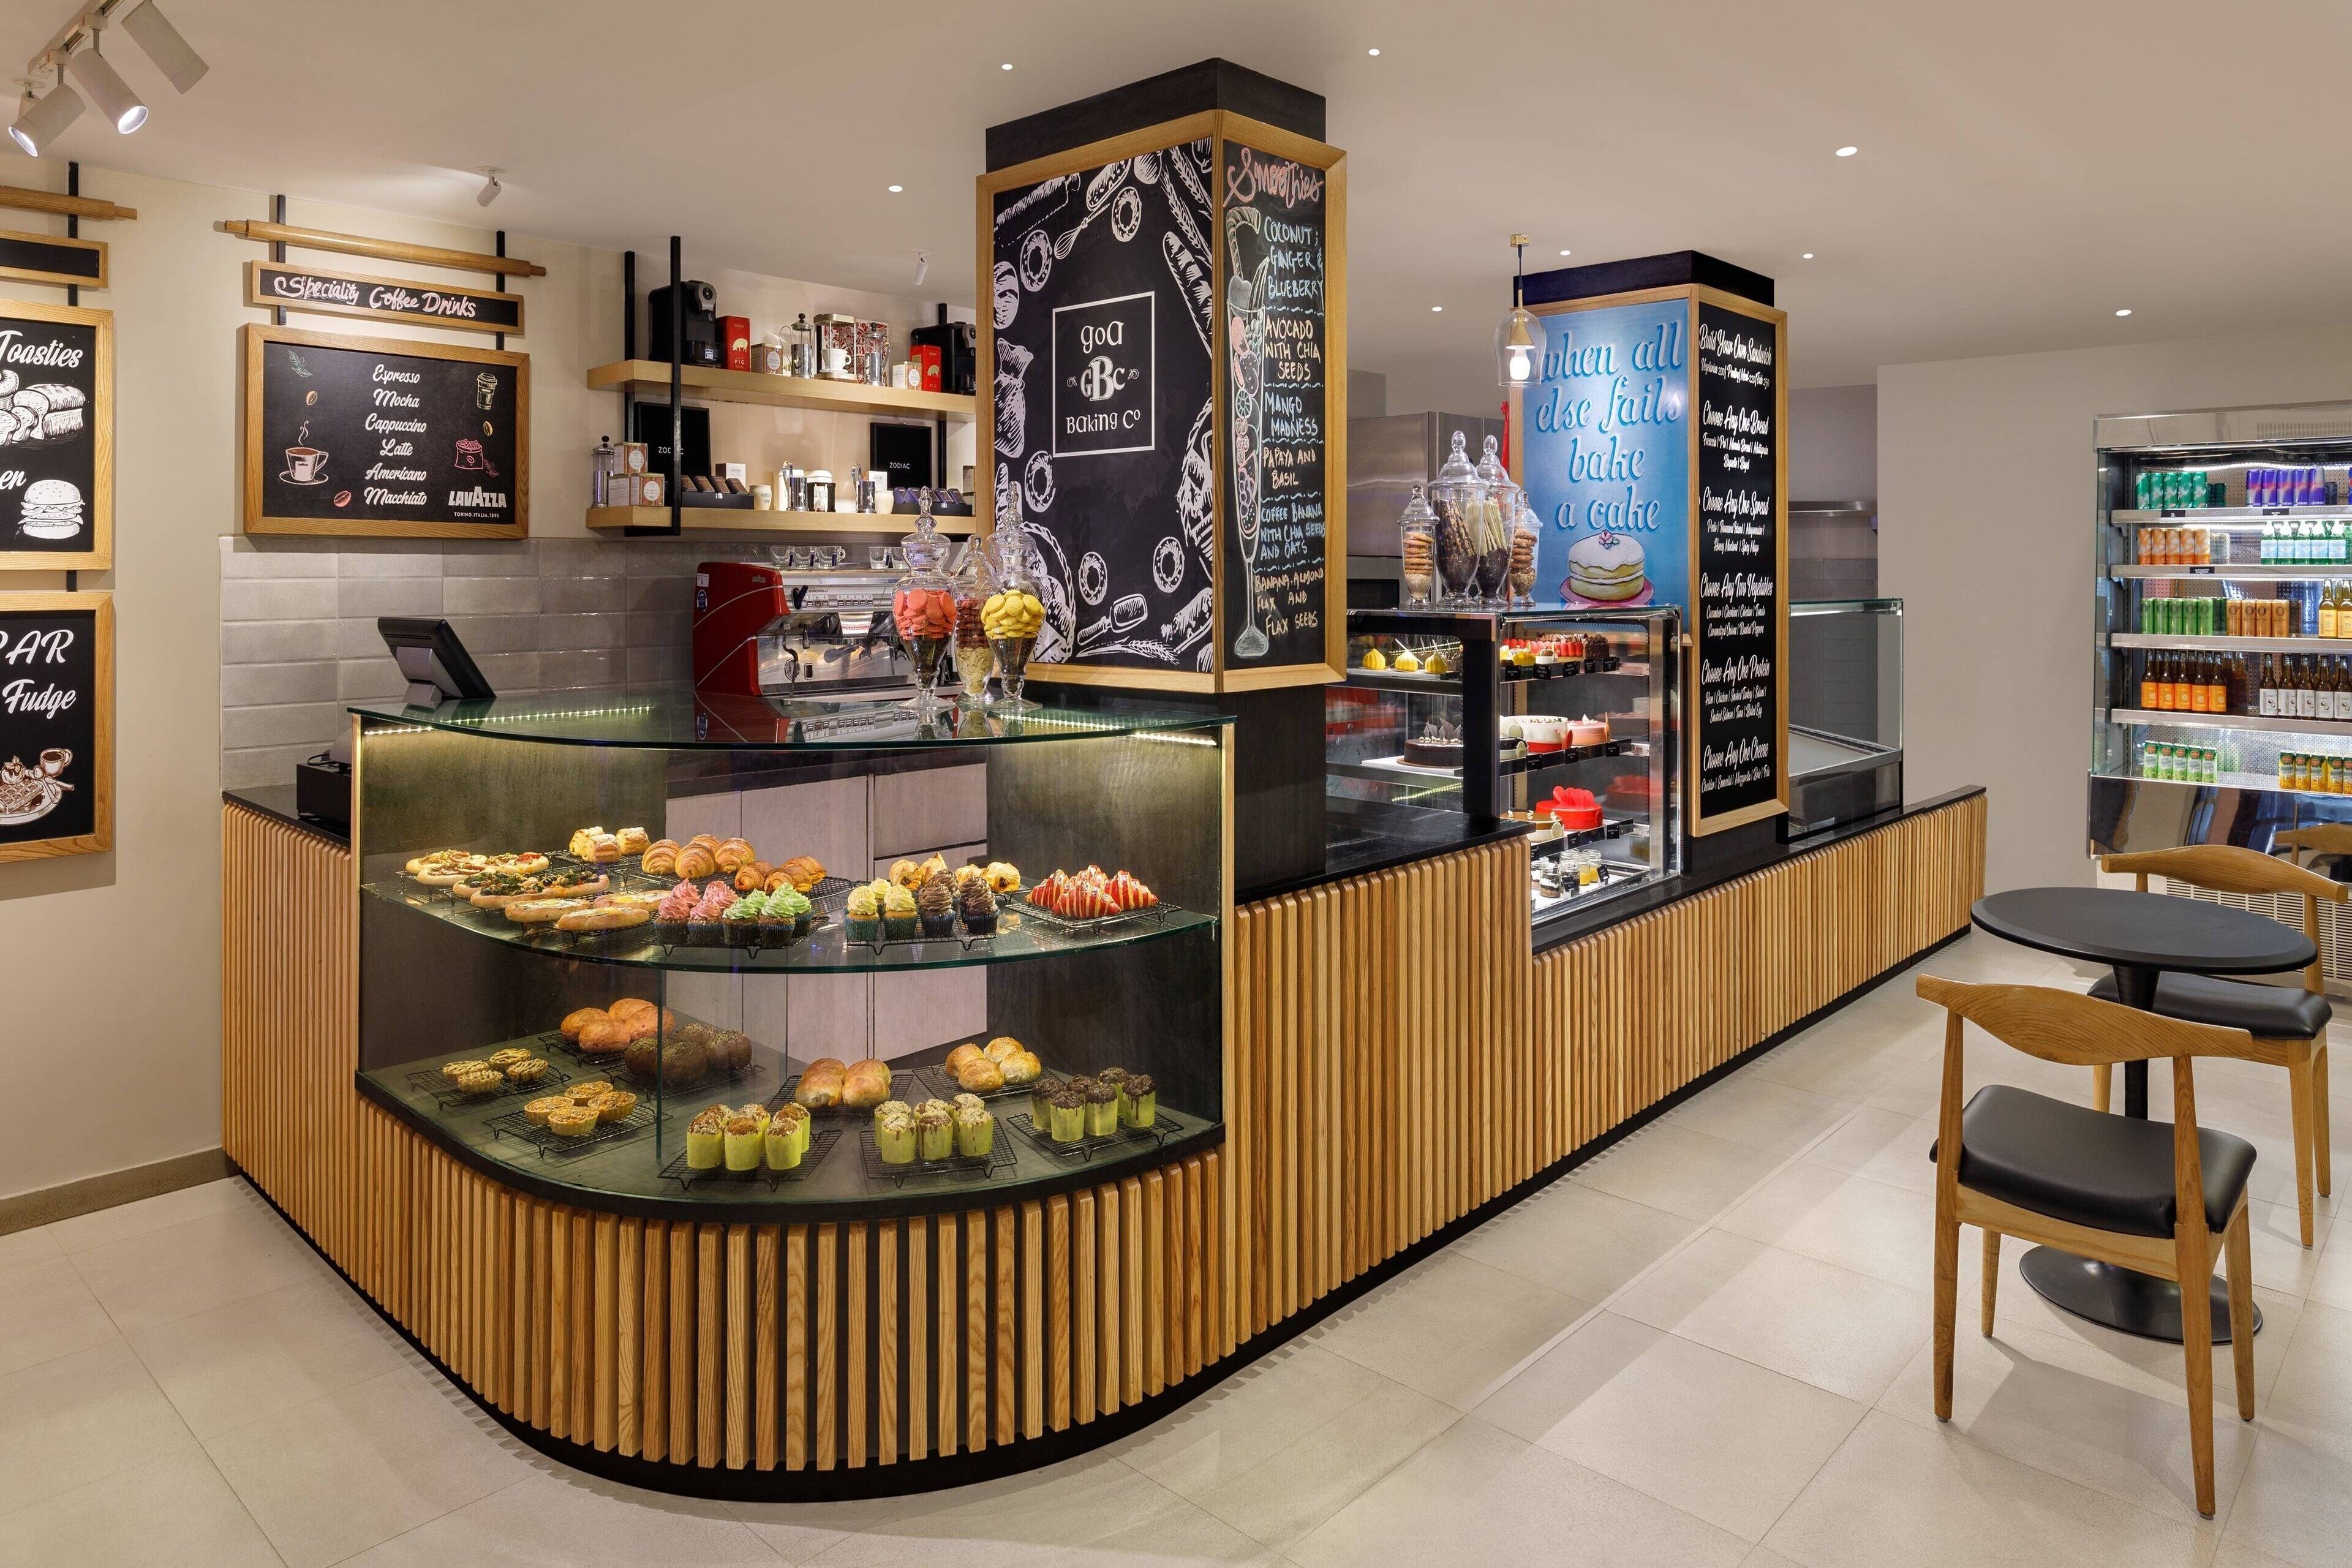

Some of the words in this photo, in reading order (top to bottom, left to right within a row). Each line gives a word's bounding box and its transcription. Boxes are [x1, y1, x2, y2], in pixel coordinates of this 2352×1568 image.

[1223, 147, 1324, 209] Smoothies
[1270, 245, 1316, 275] GINGER
[274, 276, 359, 306] Speciality
[369, 287, 420, 311] Coffee
[422, 292, 476, 318] Drinks
[1267, 275, 1324, 311] BLUEBERRY
[1265, 315, 1313, 339] AVOCADO
[1699, 323, 1717, 351] Build
[1717, 329, 1733, 356] Your
[0, 330, 83, 368] Toasties
[1265, 341, 1291, 360] WITH
[1297, 341, 1321, 364] CHIA
[1535, 330, 1620, 383] when
[1632, 320, 1684, 371] all
[372, 363, 420, 385] Espresso
[1277, 361, 1311, 382] SEEDS
[373, 388, 420, 408] Mocha
[1264, 391, 1302, 421] MANGO
[1536, 383, 1591, 434] else
[1598, 374, 1682, 434] fails
[365, 412, 427, 434] Cappuccino
[1270, 417, 1317, 437] MADNESS
[1703, 400, 1724, 427] Choose
[1724, 405, 1738, 436] Any
[1738, 407, 1750, 432] One
[1750, 410, 1769, 435] Bread
[379, 438, 413, 457] Latte
[1262, 447, 1294, 468] PAPAYA
[1297, 448, 1316, 465] AND
[1569, 434, 1645, 484] bake
[365, 462, 427, 481] Americano
[1272, 470, 1299, 489] BASIL
[364, 486, 428, 505] Macchiato
[448, 486, 507, 508] LAVAZZA
[1556, 499, 1577, 531] a
[1587, 483, 1660, 532] cake
[1703, 486, 1724, 511] Choose
[1724, 489, 1738, 519] Any
[1738, 489, 1750, 514] One
[1750, 491, 1770, 521] Spread
[1261, 506, 1288, 523] COFFEE
[1291, 502, 1323, 522] BANANA
[1261, 526, 1282, 543] WITH
[1284, 524, 1303, 543] CHIA
[1305, 521, 1325, 538] SEEDS
[1260, 543, 1280, 561] AND
[1284, 539, 1308, 559] OATS
[1294, 567, 1324, 590] ALMOND
[1700, 572, 1721, 598] Choose
[1721, 573, 1735, 603] Any
[1735, 572, 1747, 597] Two
[1257, 595, 1276, 613] FLAX
[1287, 590, 1308, 606] AND
[1265, 614, 1289, 640] FLAX
[1295, 611, 1318, 629] SEEDS
[1702, 658, 1722, 685] Choose
[1722, 657, 1737, 687] Any
[1737, 655, 1749, 681] One
[1749, 654, 1770, 679] Protein
[2, 679, 77, 720] Fudge
[1703, 744, 1724, 771] Choose
[1724, 741, 1739, 771] Any
[1739, 737, 1751, 764] One
[1751, 736, 1769, 761] Cheese
